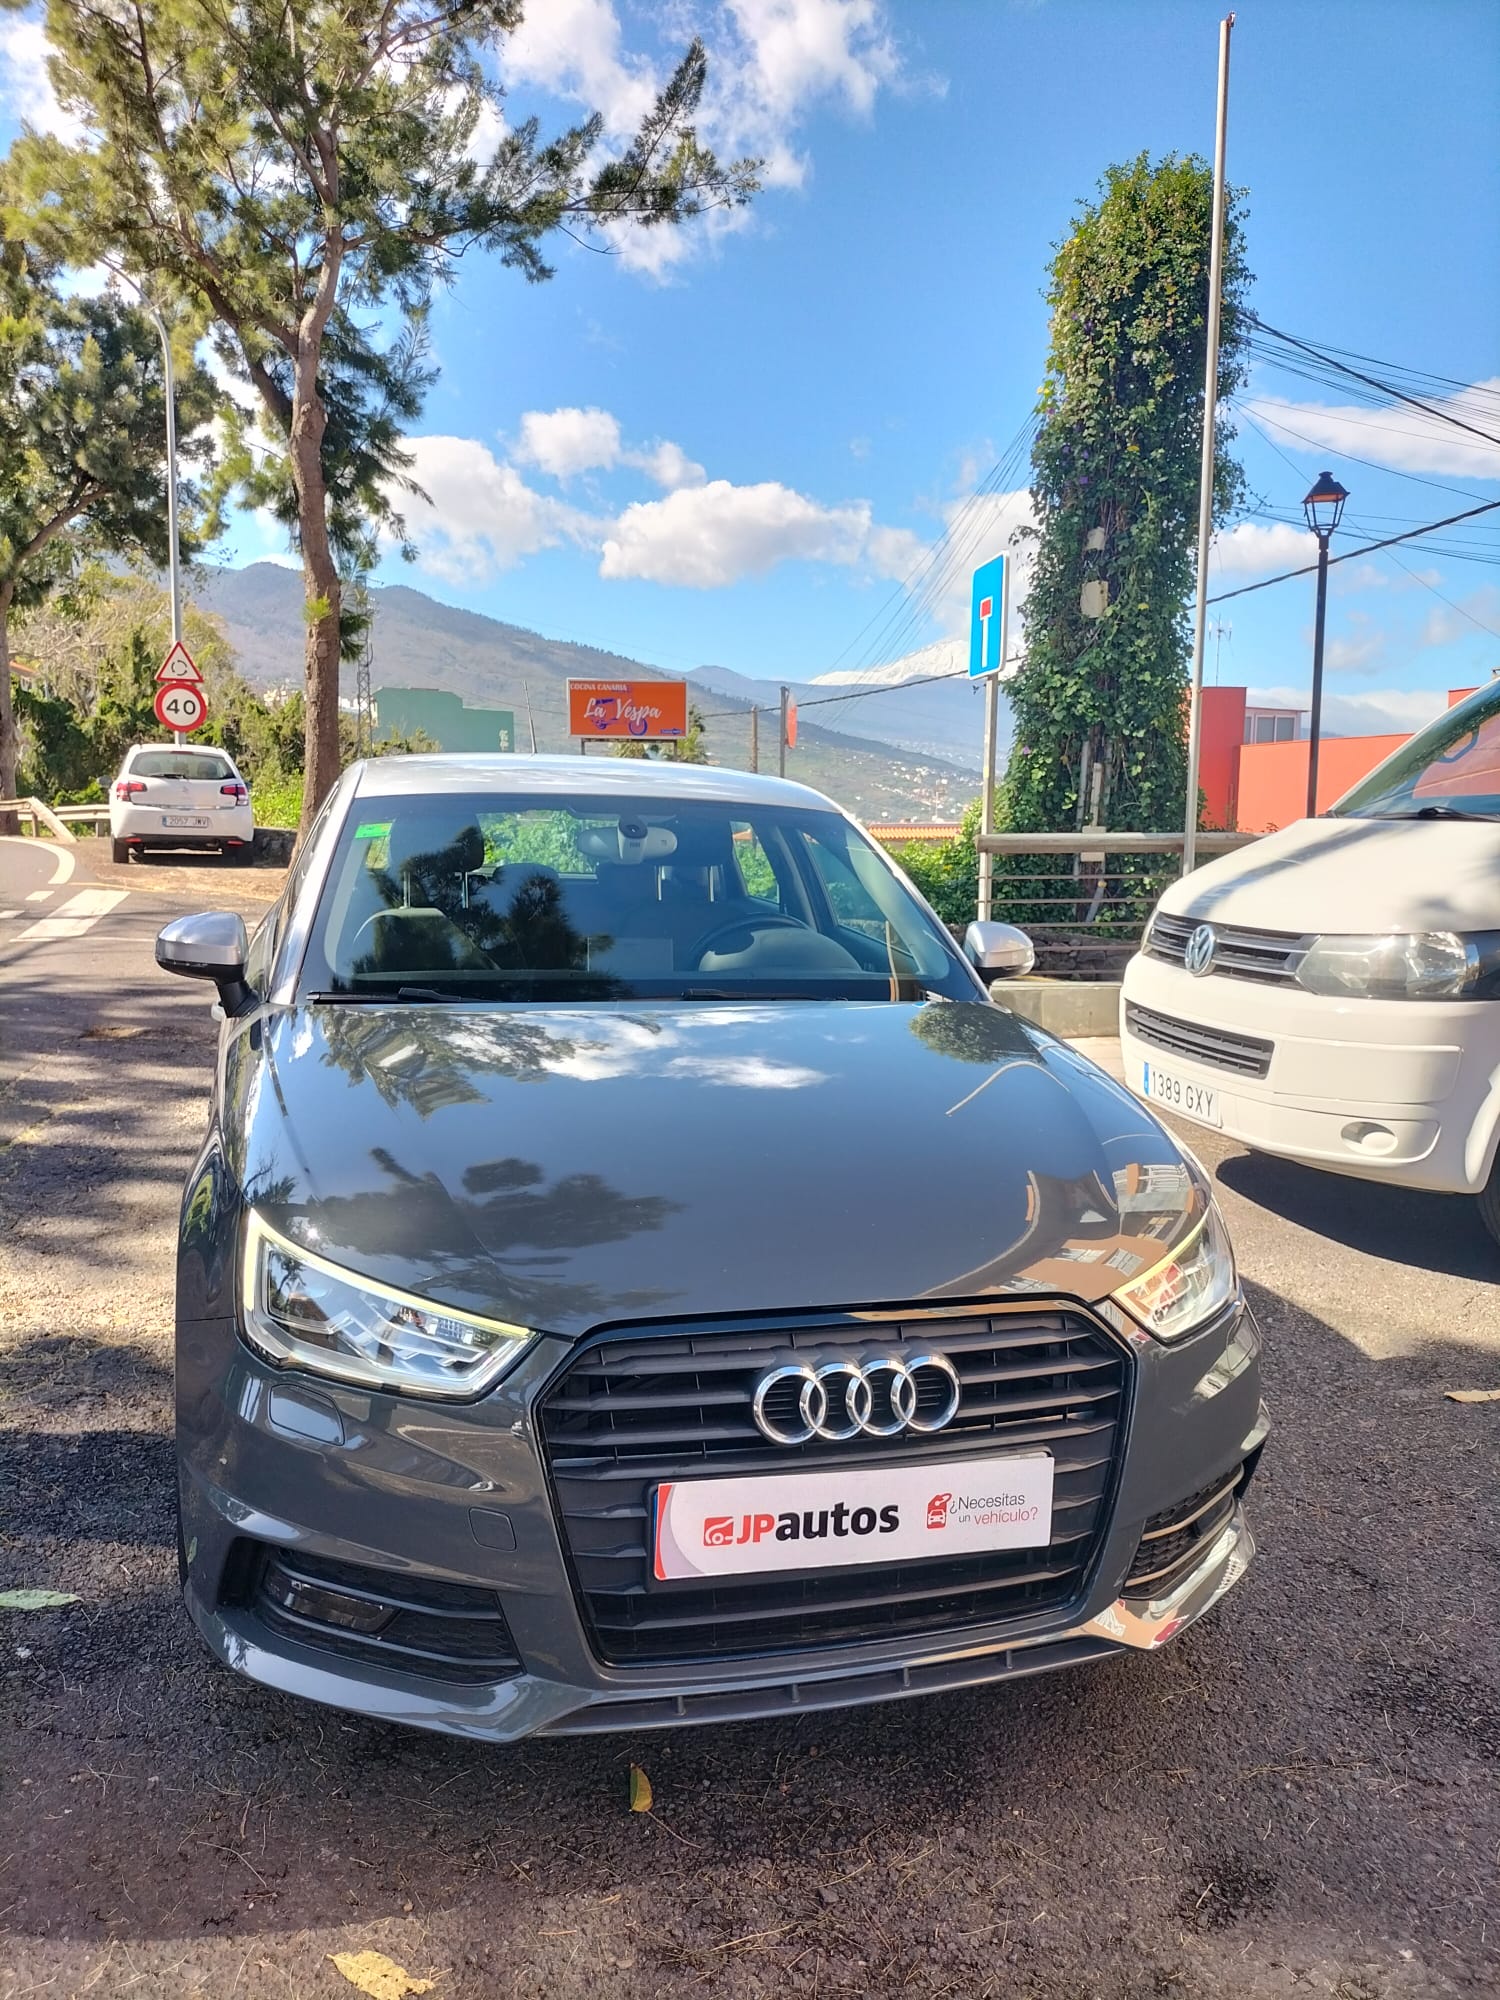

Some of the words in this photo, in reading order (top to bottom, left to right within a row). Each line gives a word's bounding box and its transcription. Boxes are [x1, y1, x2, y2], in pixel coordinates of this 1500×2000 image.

[570, 683, 596, 691] COCINA
[597, 683, 628, 691] CANARIA
[166, 699, 196, 715] 40
[584, 698, 606, 718] La
[616, 698, 662, 726] Vespa
[1152, 1071, 1181, 1104] 1389
[1186, 1085, 1214, 1117] GXY
[949, 1493, 1025, 1515] ¿Necesitas
[736, 1502, 900, 1545] JPautos
[958, 1514, 971, 1523] un
[974, 1506, 1038, 1525] vehículo?
